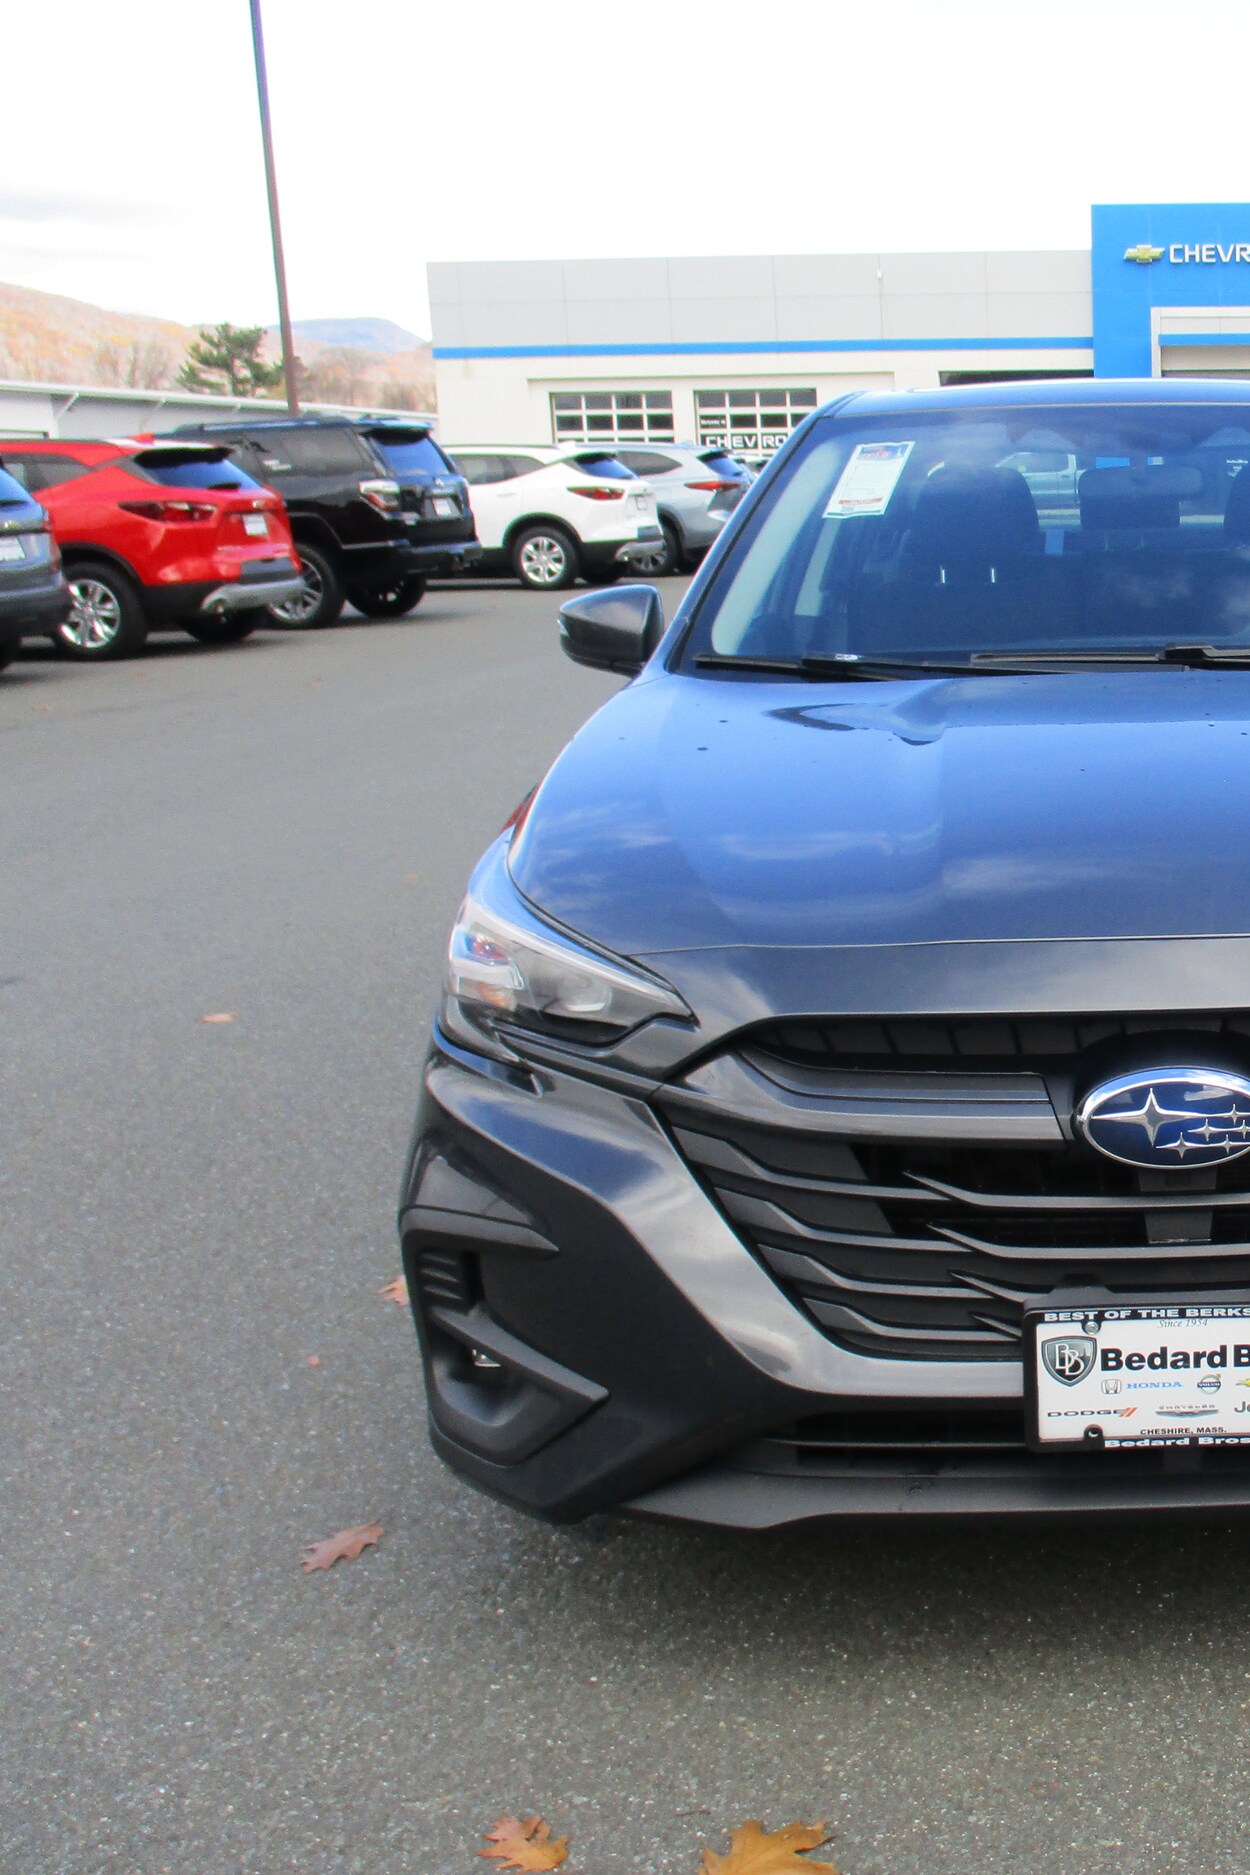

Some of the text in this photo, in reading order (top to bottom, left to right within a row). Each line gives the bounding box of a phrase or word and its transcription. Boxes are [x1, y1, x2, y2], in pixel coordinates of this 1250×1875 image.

[1044, 1311, 1098, 1322] BEST
[1104, 1310, 1132, 1319] OF
[1137, 1309, 1179, 1318] THE
[1157, 1318, 1208, 1329] Since 1954
[1101, 1345, 1227, 1371] Bedard
[1126, 1381, 1183, 1390] HONDA
[1140, 1426, 1227, 1436] CHESHIRE, MASS.
[1104, 1437, 1190, 1448] Bedard
